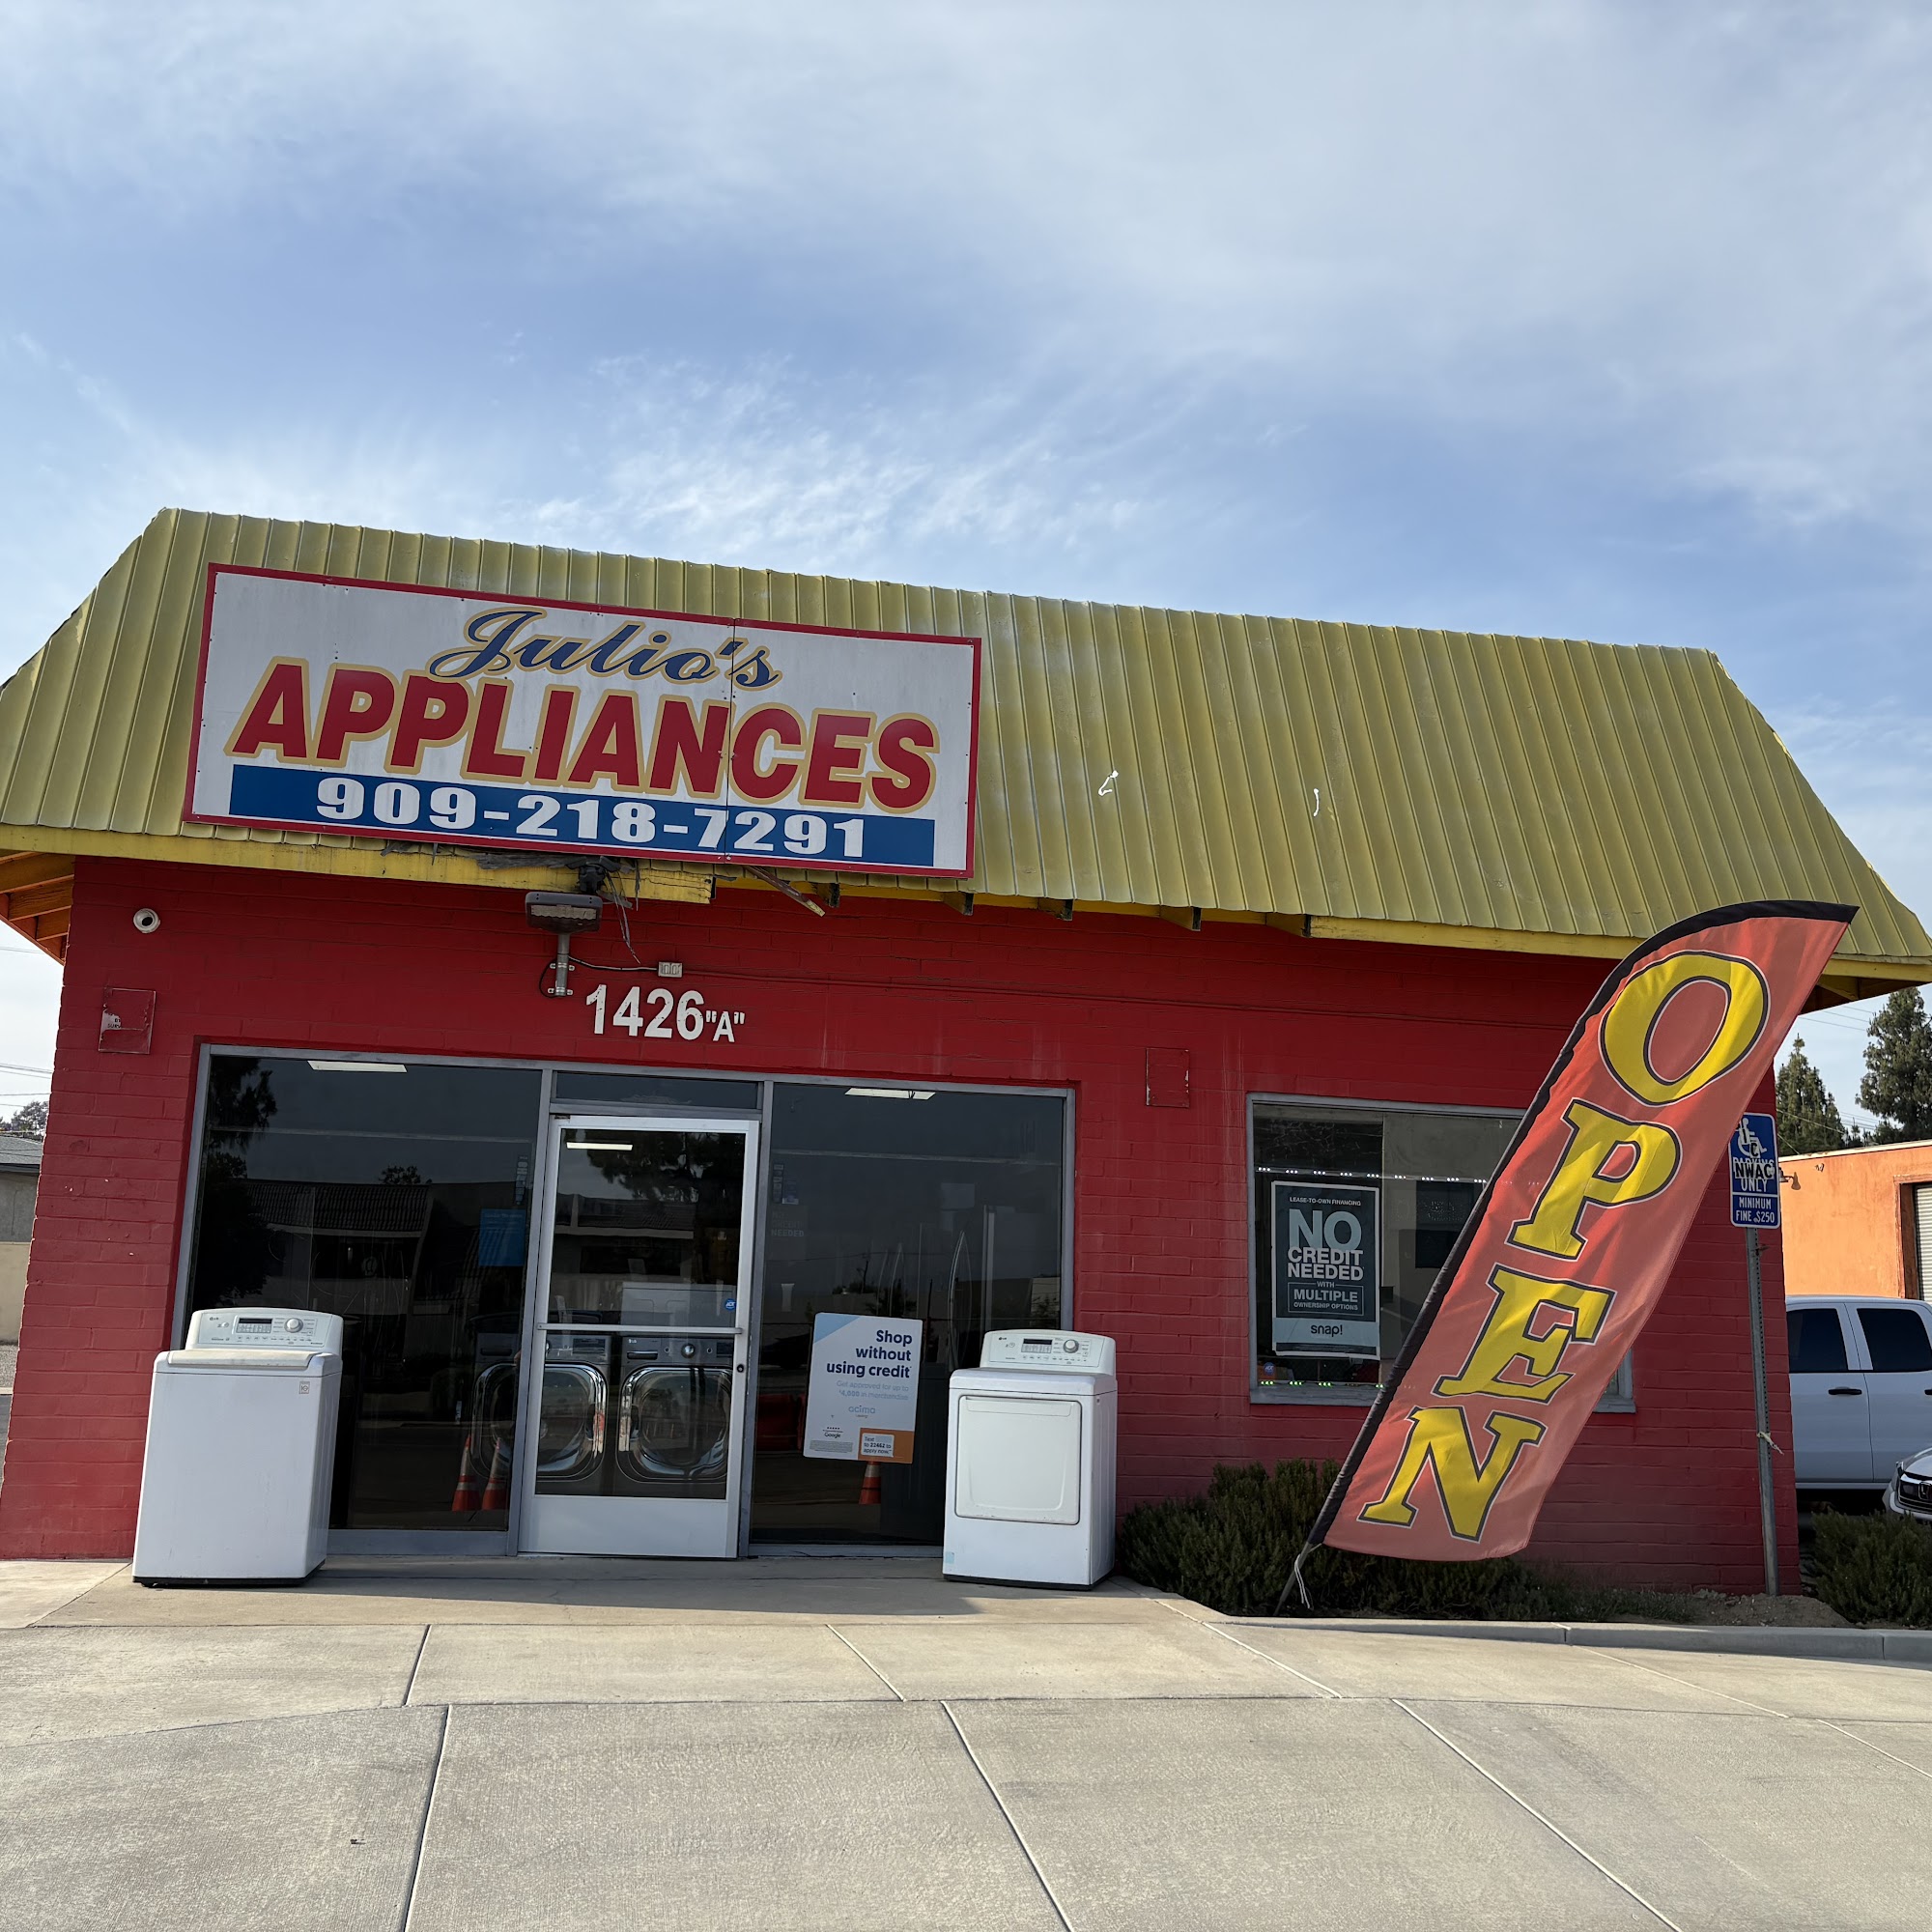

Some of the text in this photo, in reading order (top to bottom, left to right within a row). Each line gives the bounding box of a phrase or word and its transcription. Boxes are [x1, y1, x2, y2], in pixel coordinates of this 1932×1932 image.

[430, 607, 781, 689] Julio's
[228, 659, 938, 811] APPLIANCES
[317, 777, 865, 858] 909-218-7291
[1741, 1178, 1768, 1192] ONLY
[1290, 1196, 1331, 1205] LEASE-TO-OWN
[1739, 1197, 1772, 1209] MINIMUM
[1736, 1210, 1776, 1223] FINE $250
[1289, 1208, 1363, 1251] NO
[1356, 951, 1771, 1542] OPEN
[1288, 1246, 1364, 1266] CREDIT
[1288, 1262, 1364, 1281] NEEDED
[1317, 1280, 1335, 1289] WITH
[1293, 1289, 1358, 1303] MULTIPLE
[875, 1329, 913, 1347] Shop
[1310, 1323, 1344, 1338] snap!
[856, 1346, 912, 1362] without
[826, 1361, 866, 1378] using
[850, 1380, 881, 1390] approved
[848, 1405, 876, 1414] acima
